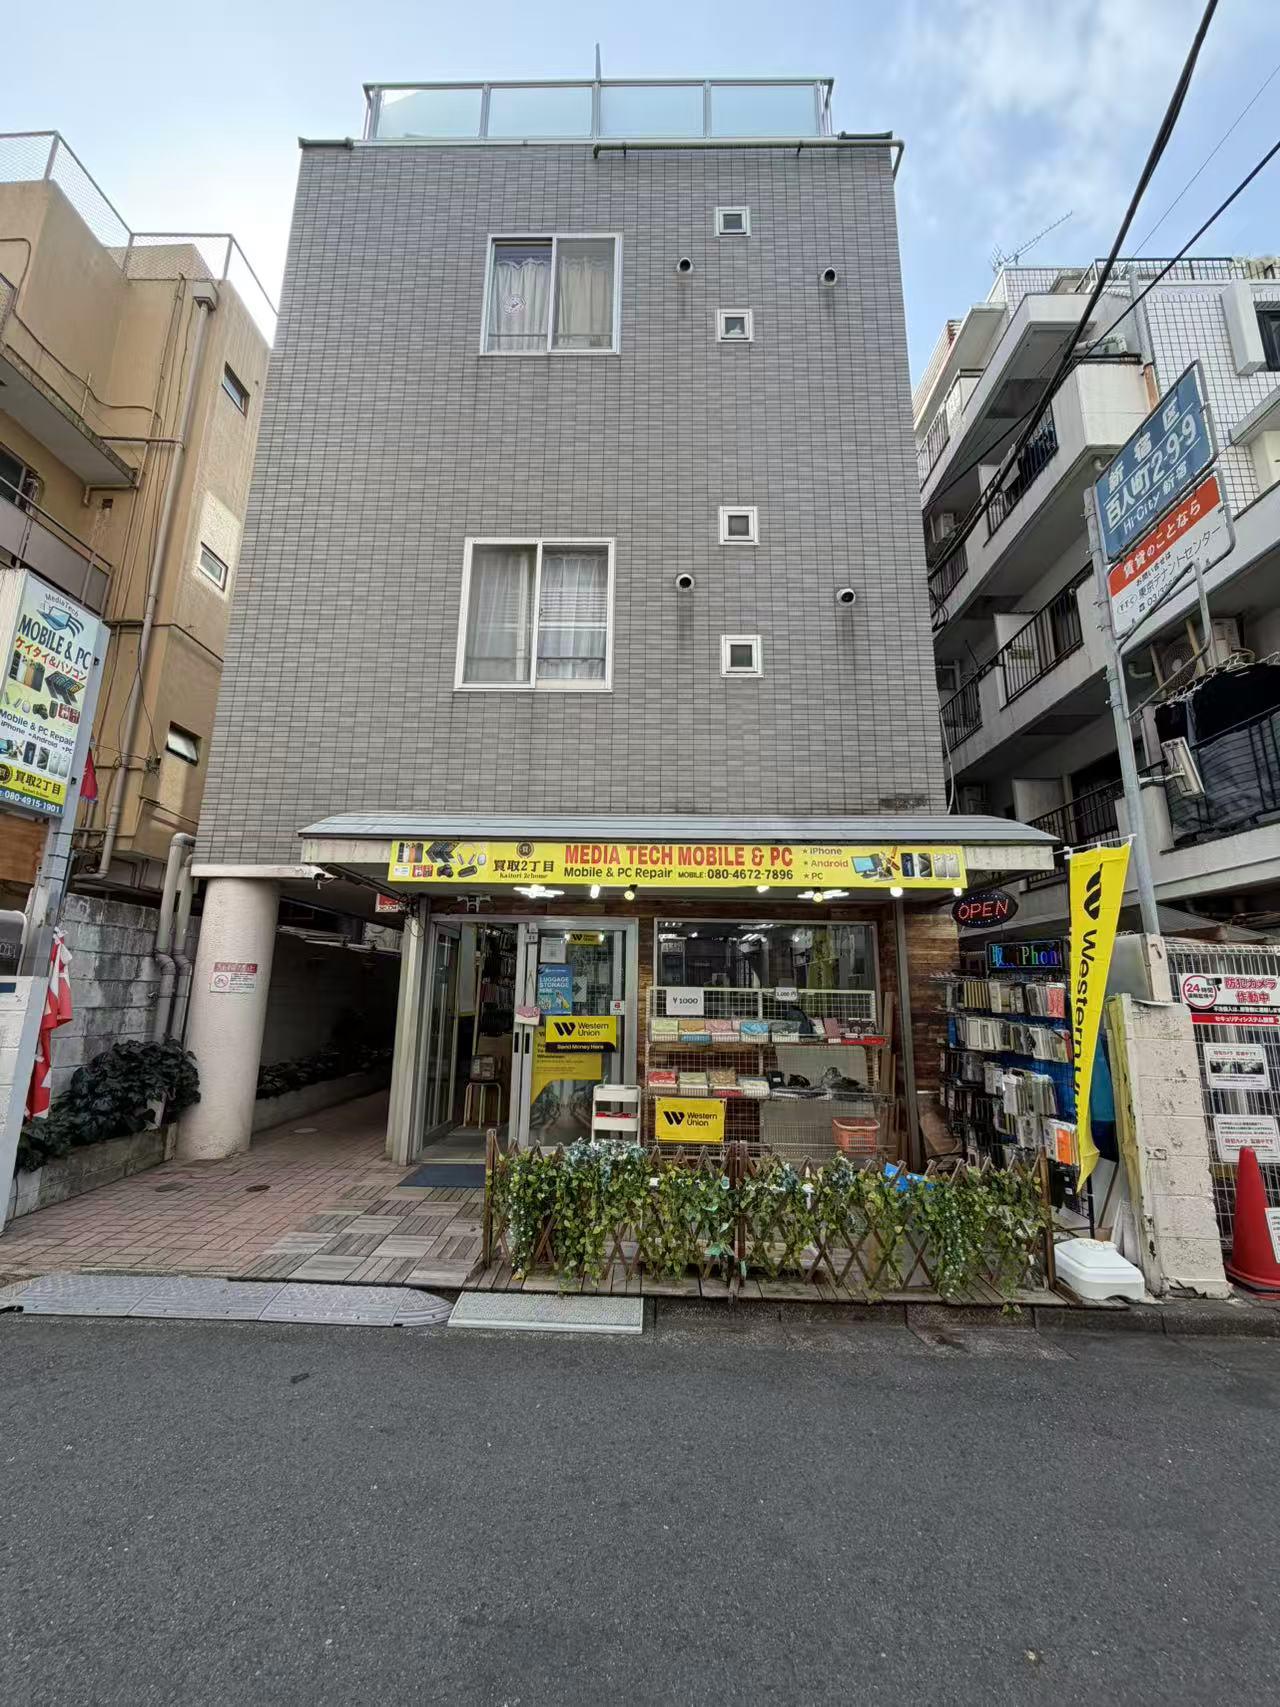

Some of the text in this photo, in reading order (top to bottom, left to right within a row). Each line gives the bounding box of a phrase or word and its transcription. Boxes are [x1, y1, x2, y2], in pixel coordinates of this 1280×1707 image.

[1108, 397, 1180, 494] 新宿区
[1105, 413, 1197, 528] 百人町2-9-9
[1123, 460, 1187, 534] Hi-City 新宿
[1123, 500, 1201, 579] 賃貸のことなら
[1139, 526, 1221, 599] 東京テナントセンター
[18, 614, 92, 670] MOBILE & PC
[15, 636, 87, 680] ケイタイ&パソコン
[0, 709, 75, 747] Mobile & PC Repair
[15, 769, 62, 795] 買取2丁目
[4, 790, 61, 813] 080-4915-1901
[565, 844, 794, 867] MEDIA TECH MOBILE & PC
[810, 847, 842, 855] iPhone
[493, 860, 555, 873] 買取2丁目
[564, 867, 603, 878] Mobile
[606, 868, 614, 878] &
[617, 867, 633, 878] PC
[635, 867, 674, 880] Repair
[707, 868, 794, 880] 080-4672-7896
[810, 860, 849, 868] Android
[811, 872, 824, 880] PC
[957, 899, 1009, 920] OPEN
[1074, 929, 1098, 1060] Western
[1223, 976, 1278, 990] 防犯カメラ
[577, 1022, 609, 1030] Western
[687, 1112, 718, 1120] Western
[687, 1119, 709, 1127] Union
